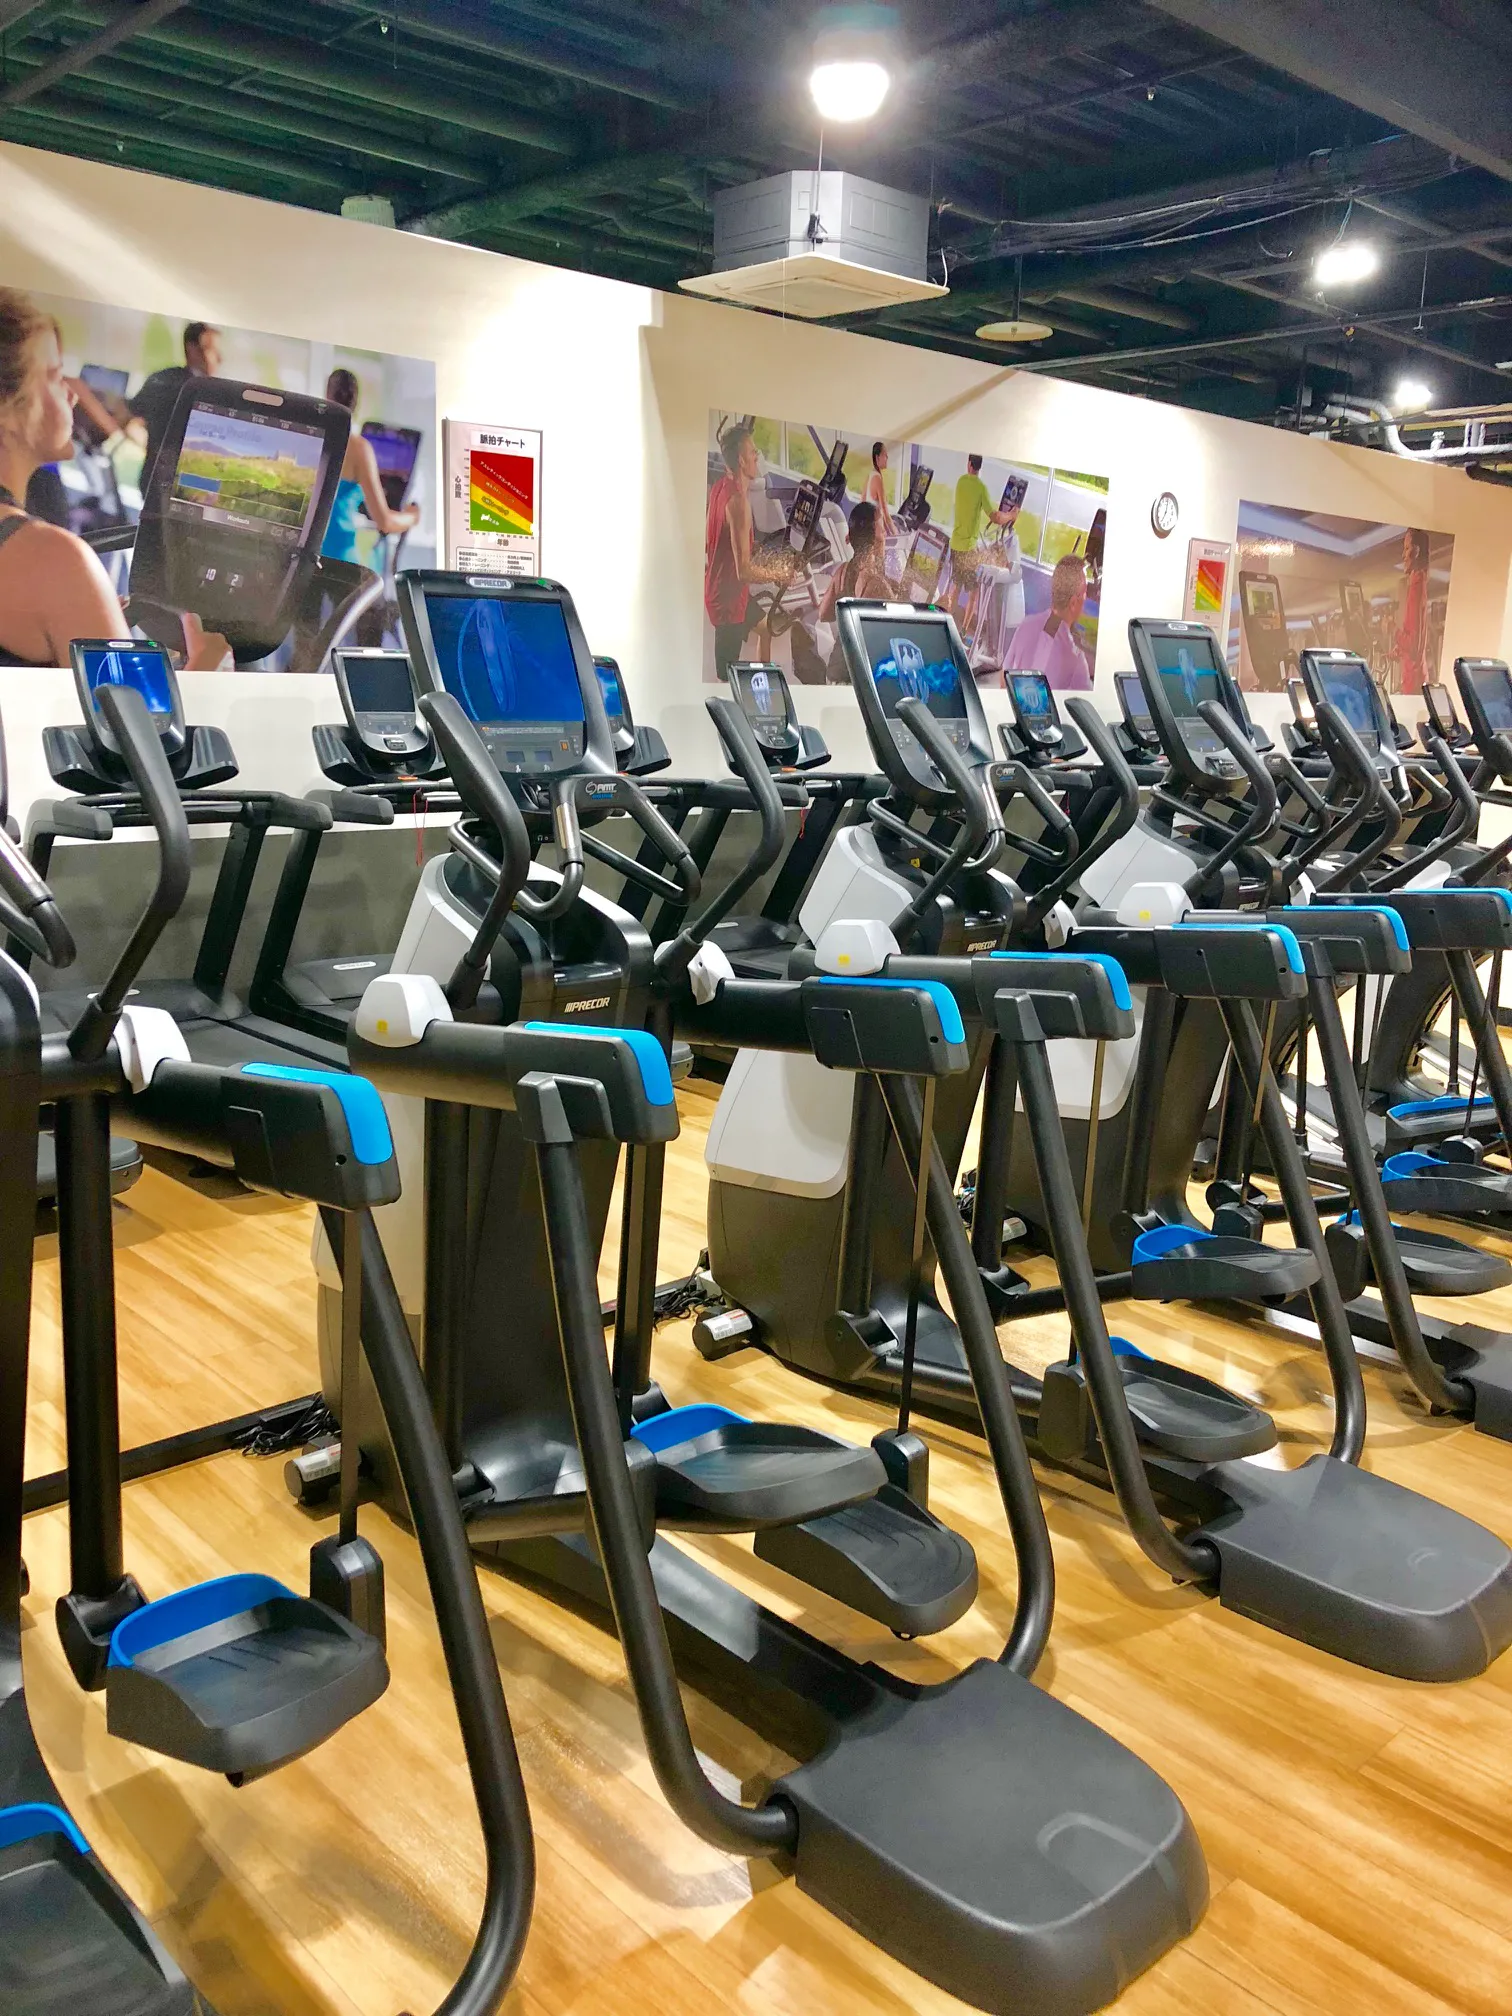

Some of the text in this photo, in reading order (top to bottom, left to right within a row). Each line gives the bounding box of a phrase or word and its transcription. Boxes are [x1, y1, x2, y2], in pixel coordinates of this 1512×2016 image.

[480, 433, 526, 449] 脈拍チャート
[227, 514, 250, 525] Workouts
[477, 578, 508, 588] PRECOR
[566, 997, 610, 1013] PRECOR
